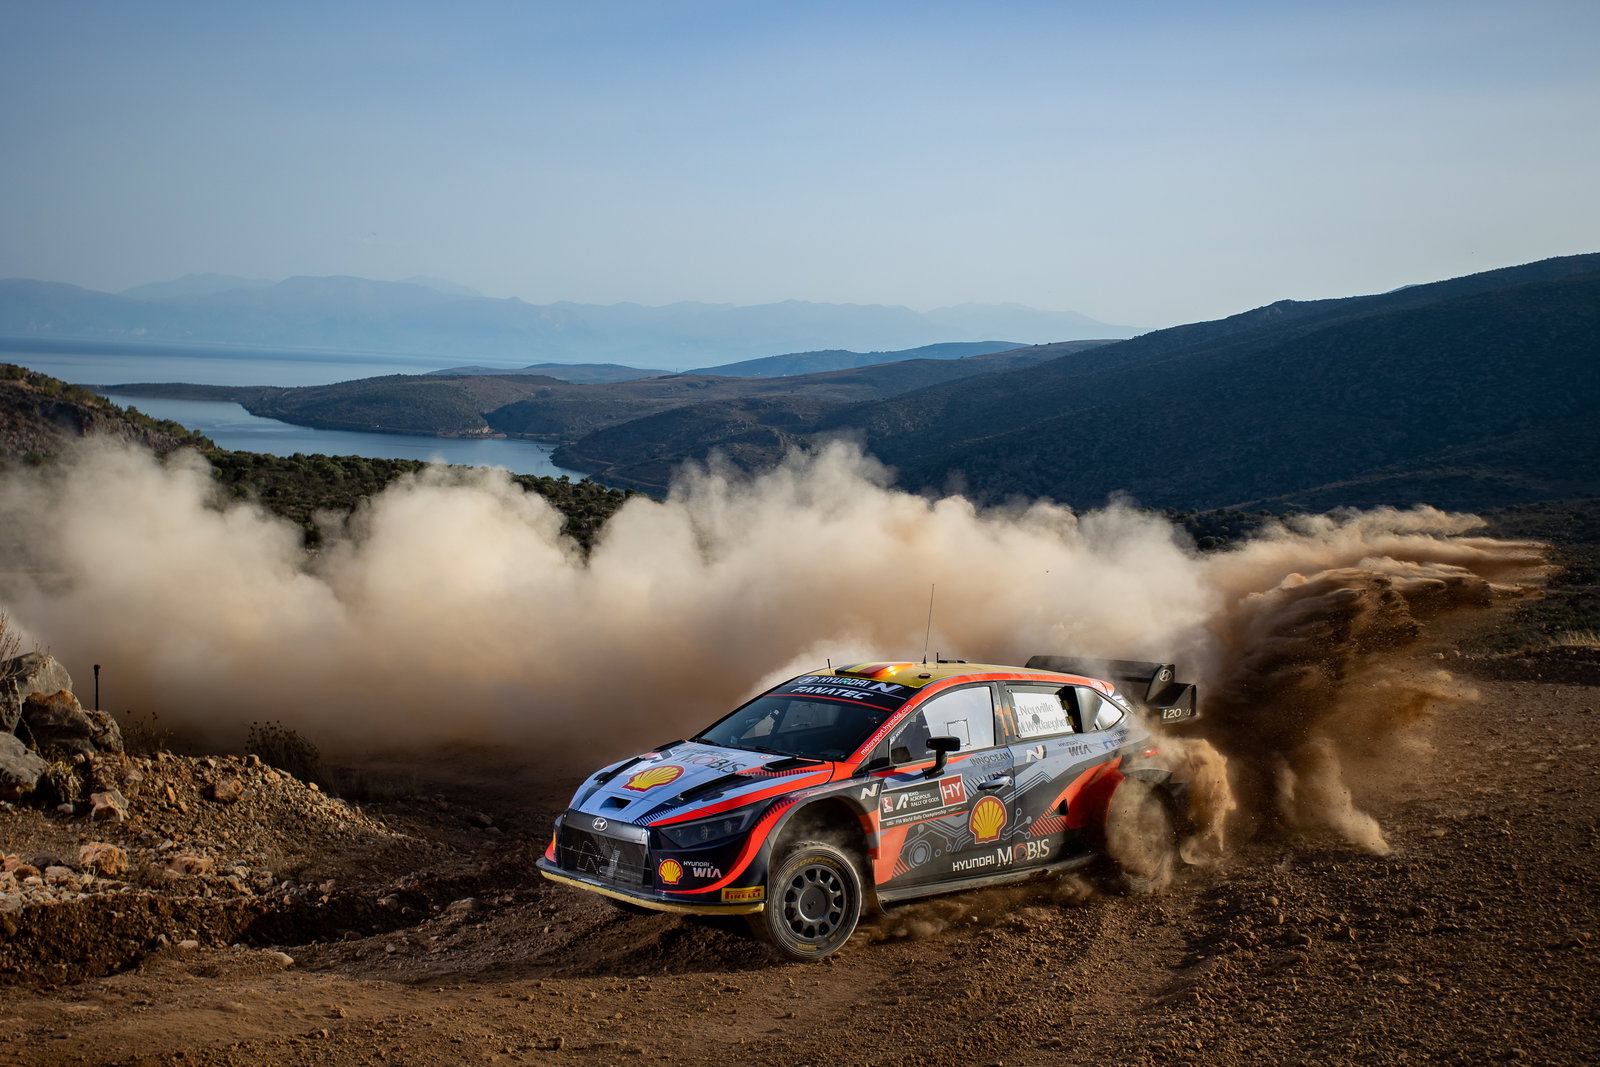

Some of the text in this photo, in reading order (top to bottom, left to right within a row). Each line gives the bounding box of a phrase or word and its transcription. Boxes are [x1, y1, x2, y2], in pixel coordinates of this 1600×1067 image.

[817, 676, 871, 687] HYUNDAI
[791, 686, 871, 699] FANATEC
[860, 704, 913, 756] motorsport.hyundai.com
[1068, 744, 1092, 757] WIA
[969, 751, 1010, 766] INNOCEAN
[942, 782, 961, 800] HY
[952, 838, 1050, 872] HYUNDAI MOBIS
[683, 860, 710, 868] HYUNDAI
[692, 866, 722, 879] WIA
[724, 888, 761, 900] PIRELLI
